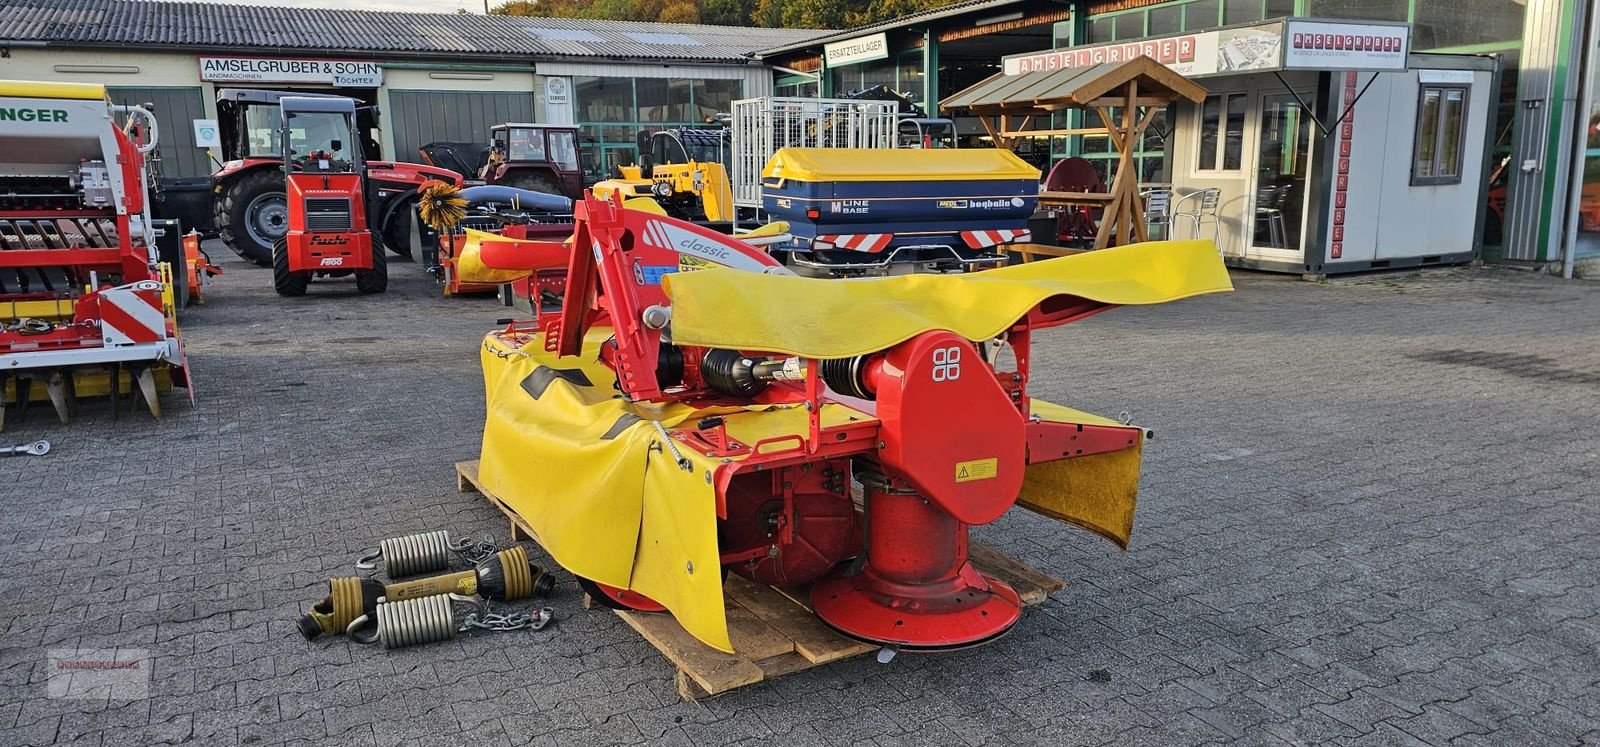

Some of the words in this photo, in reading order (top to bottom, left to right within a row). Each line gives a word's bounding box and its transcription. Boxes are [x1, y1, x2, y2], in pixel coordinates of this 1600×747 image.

[829, 40, 882, 59] ERSATZTEILLAGER
[1294, 34, 1401, 50] AMSELGRUBER
[1020, 37, 1195, 72] AMSELGRUBER
[204, 60, 320, 74] AMSELGRUBER
[323, 62, 333, 74] &
[335, 63, 378, 74] SOHN
[831, 201, 842, 213] M
[680, 238, 730, 260] classic
